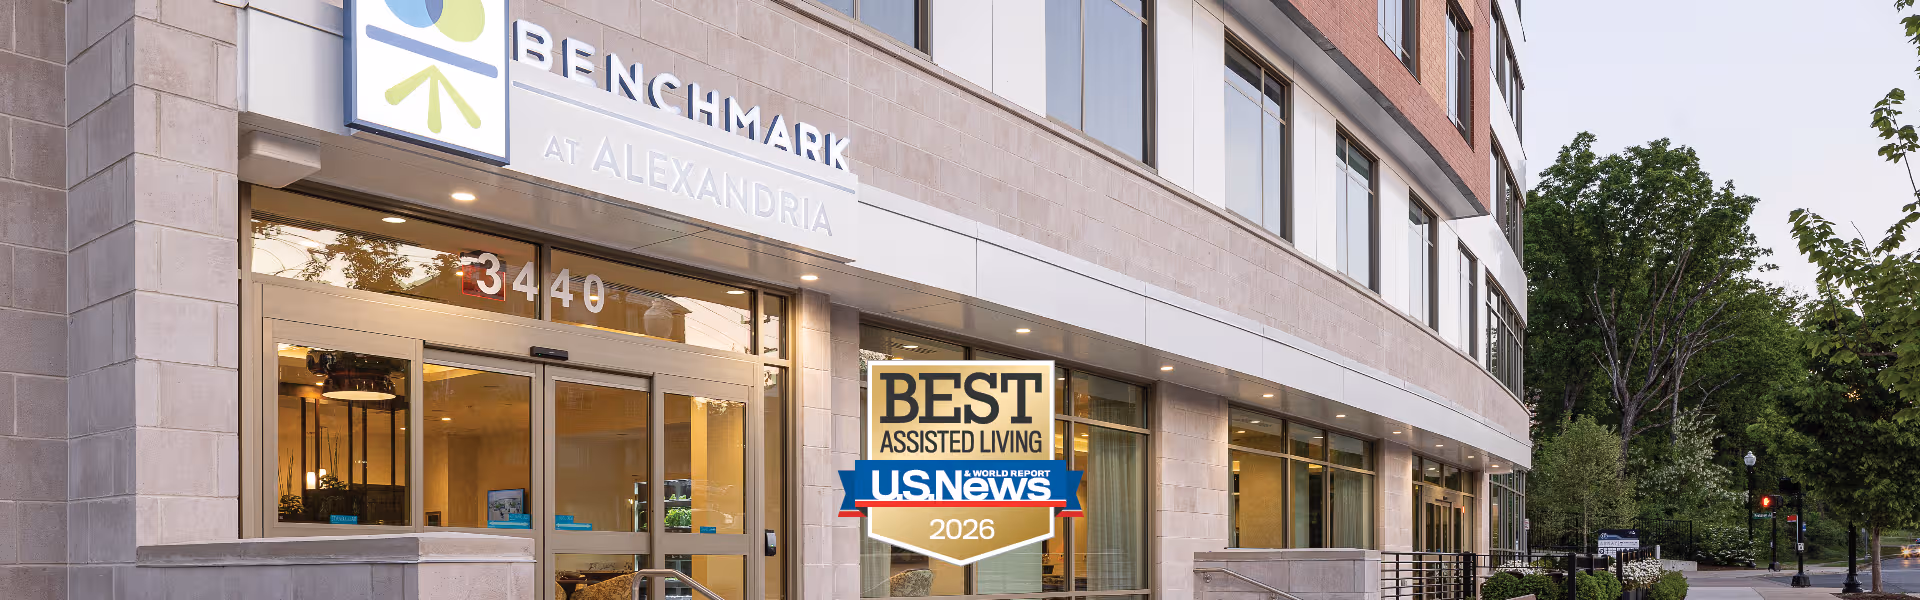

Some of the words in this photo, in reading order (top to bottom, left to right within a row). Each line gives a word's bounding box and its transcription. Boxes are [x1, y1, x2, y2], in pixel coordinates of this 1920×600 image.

[512, 19, 850, 173] BENCHMARK
[543, 135, 579, 165] AT
[592, 136, 832, 237] ALEXANDRIA
[476, 252, 605, 314] 3440
